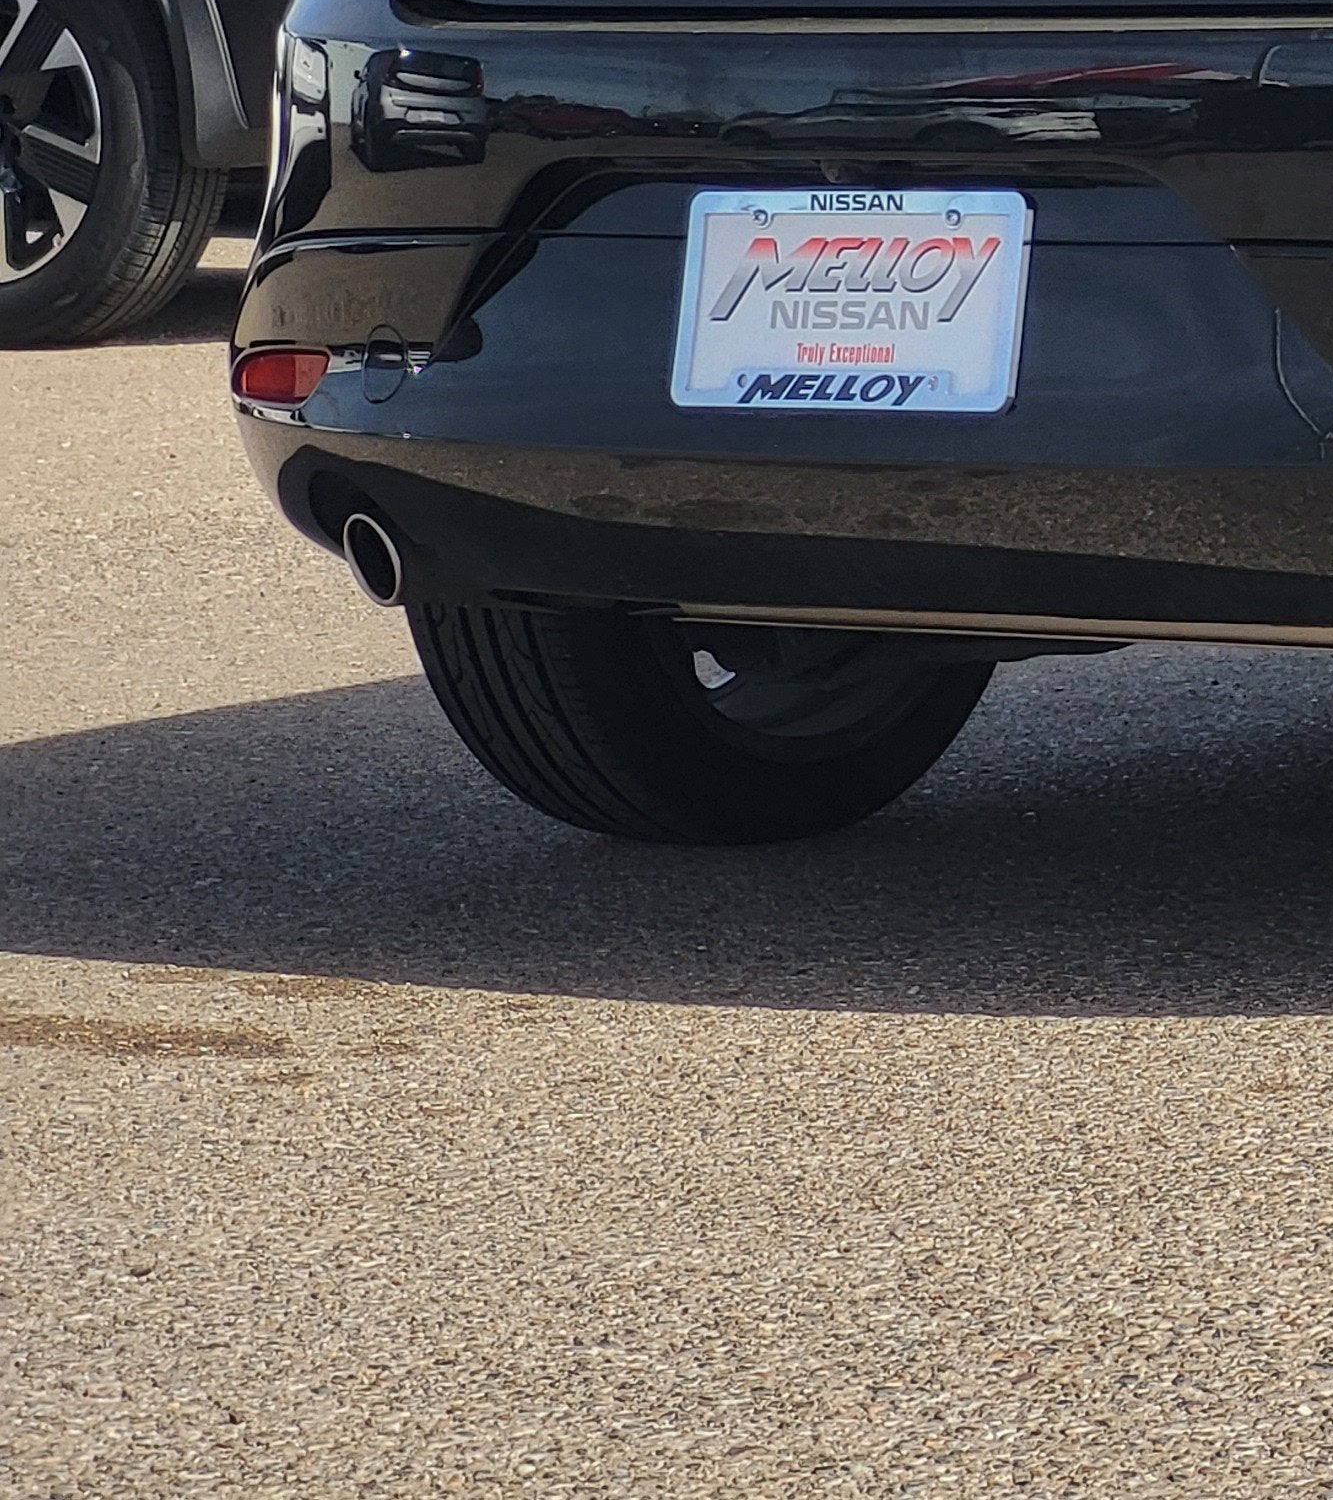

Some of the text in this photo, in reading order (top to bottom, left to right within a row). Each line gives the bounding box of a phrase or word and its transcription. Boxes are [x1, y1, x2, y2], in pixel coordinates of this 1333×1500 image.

[810, 194, 903, 211] NISSAN
[709, 237, 1001, 322] MELLOY
[770, 300, 929, 330] NISSAN
[797, 342, 895, 366] Truly Exceptional
[738, 374, 926, 406] MELLOY
